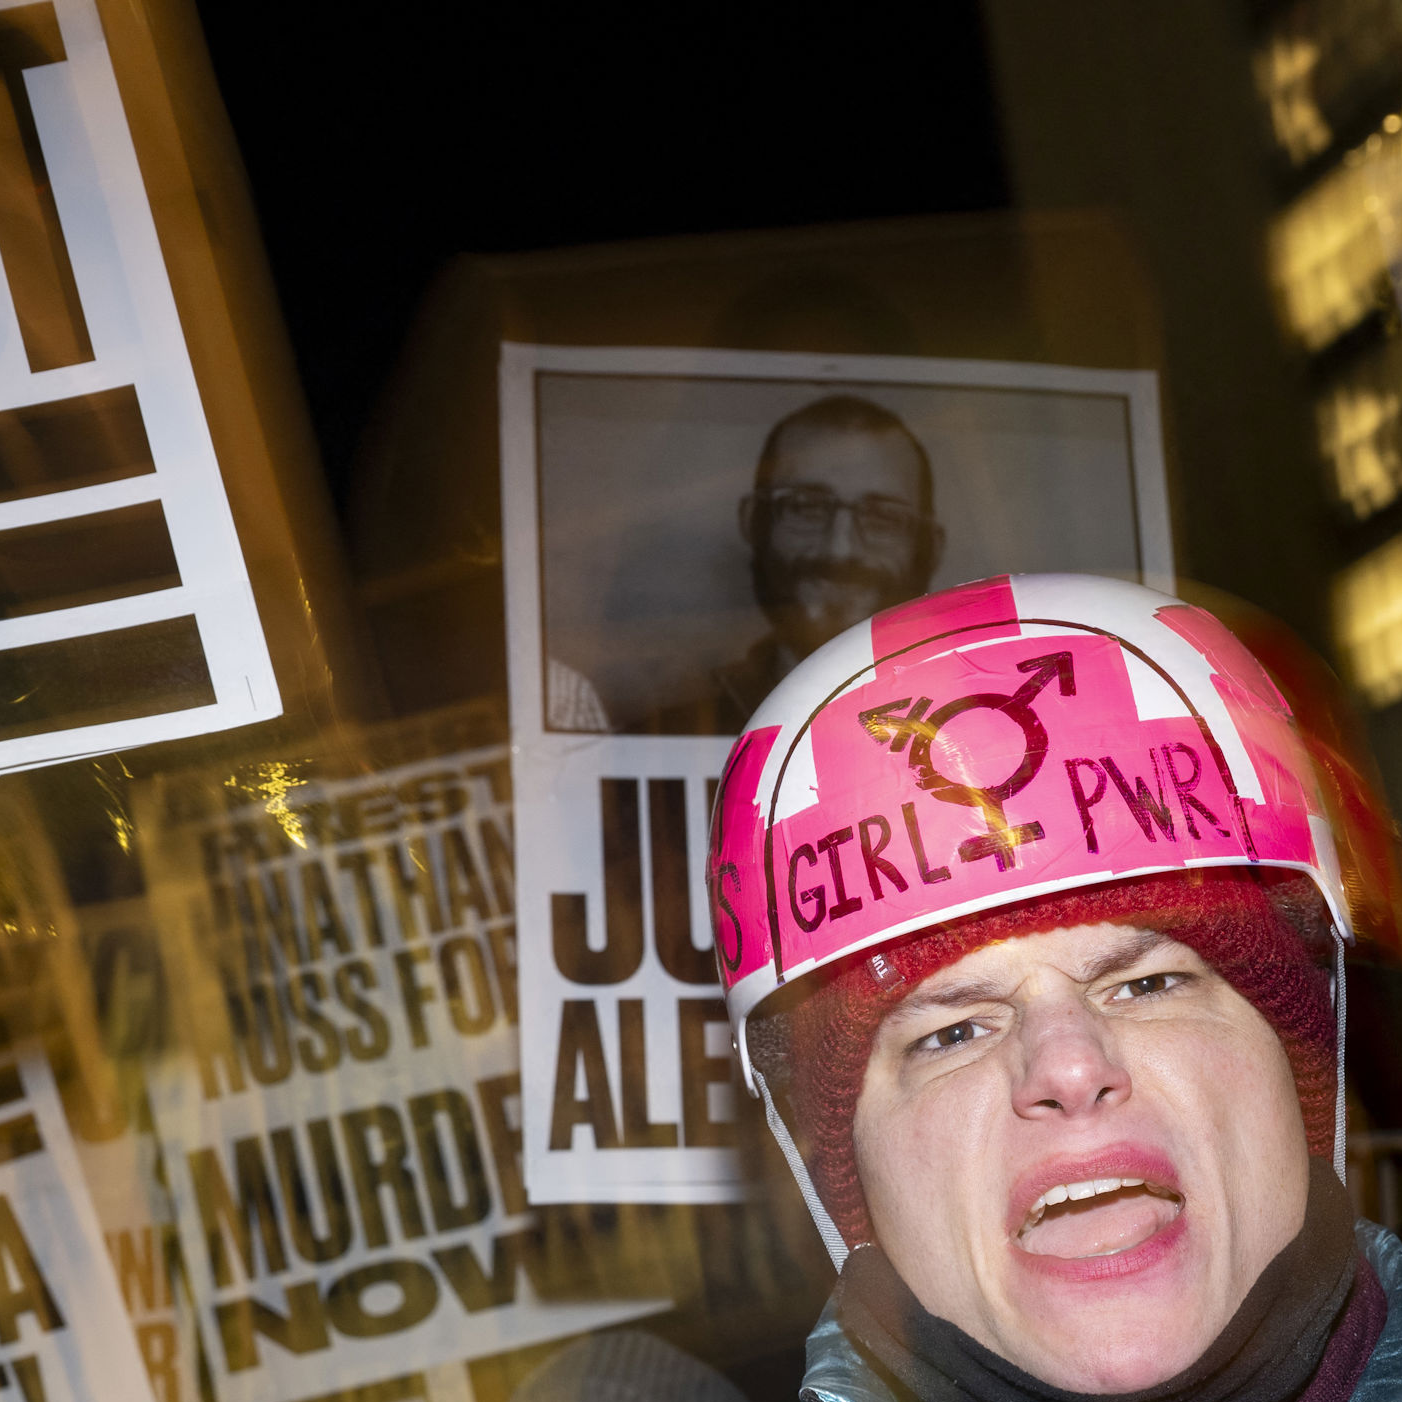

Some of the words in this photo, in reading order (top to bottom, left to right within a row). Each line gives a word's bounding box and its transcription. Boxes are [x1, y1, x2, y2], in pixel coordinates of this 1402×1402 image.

[788, 802, 952, 933] GIRL
[1063, 742, 1231, 855] PWR
[549, 997, 733, 1152] ALE
